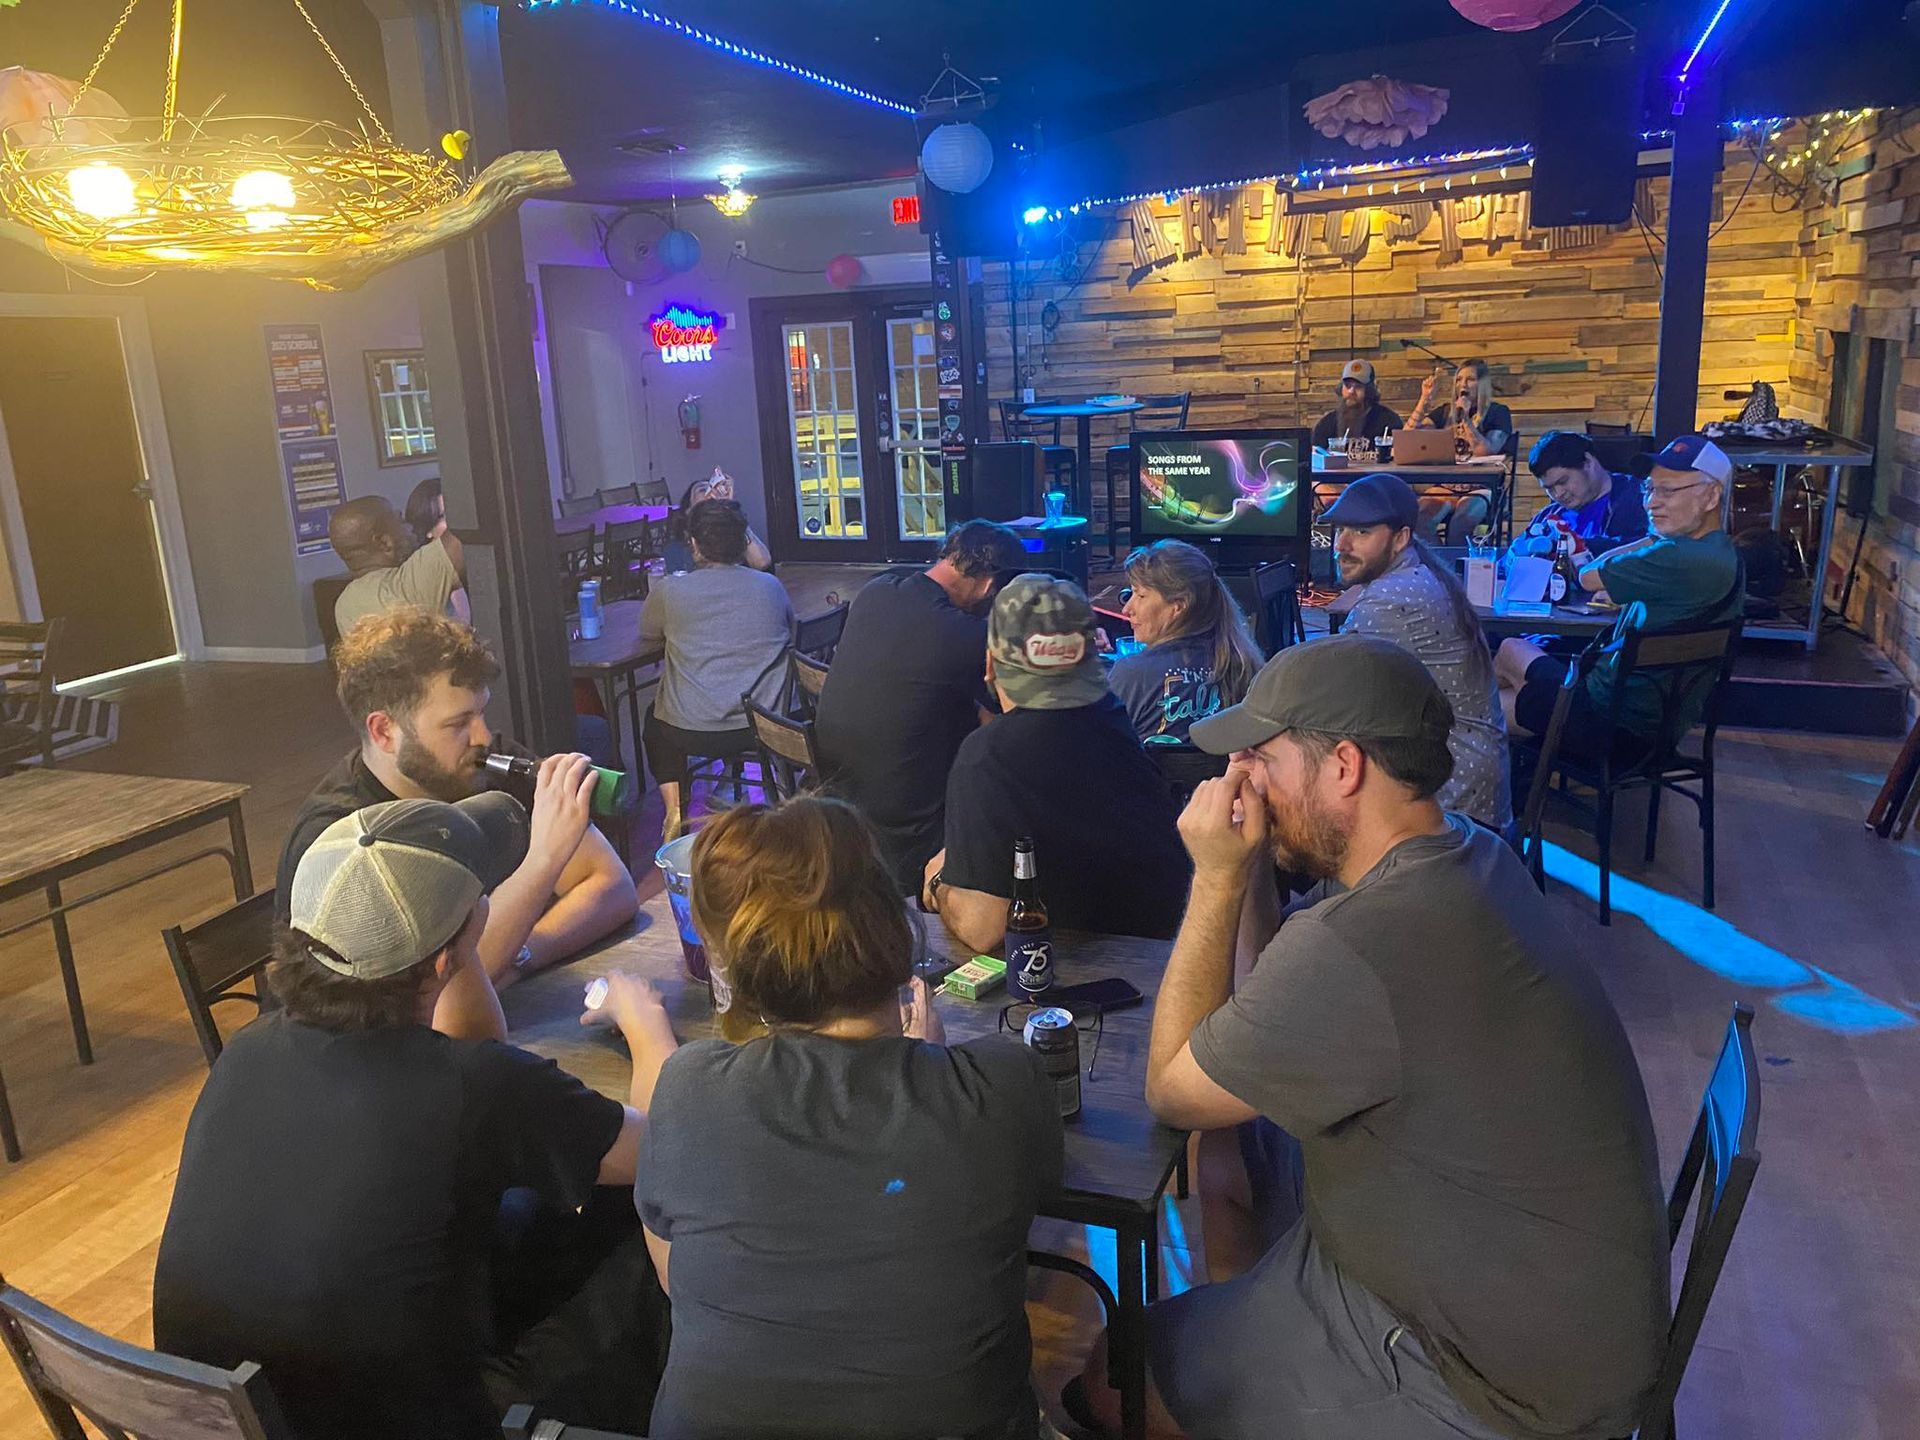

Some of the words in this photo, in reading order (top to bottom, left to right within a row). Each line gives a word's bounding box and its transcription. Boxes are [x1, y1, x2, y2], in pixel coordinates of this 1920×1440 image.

[1132, 180, 1722, 269] ARTMOSPH
[652, 320, 717, 348] Coors
[661, 344, 712, 363] LIGHT
[1148, 455, 1175, 464] SONGS
[1177, 455, 1202, 464] FROM
[1148, 467, 1164, 475] THE
[1165, 467, 1188, 475] SAME
[1189, 466, 1211, 475] YEAR
[1022, 945, 1049, 972] 75
